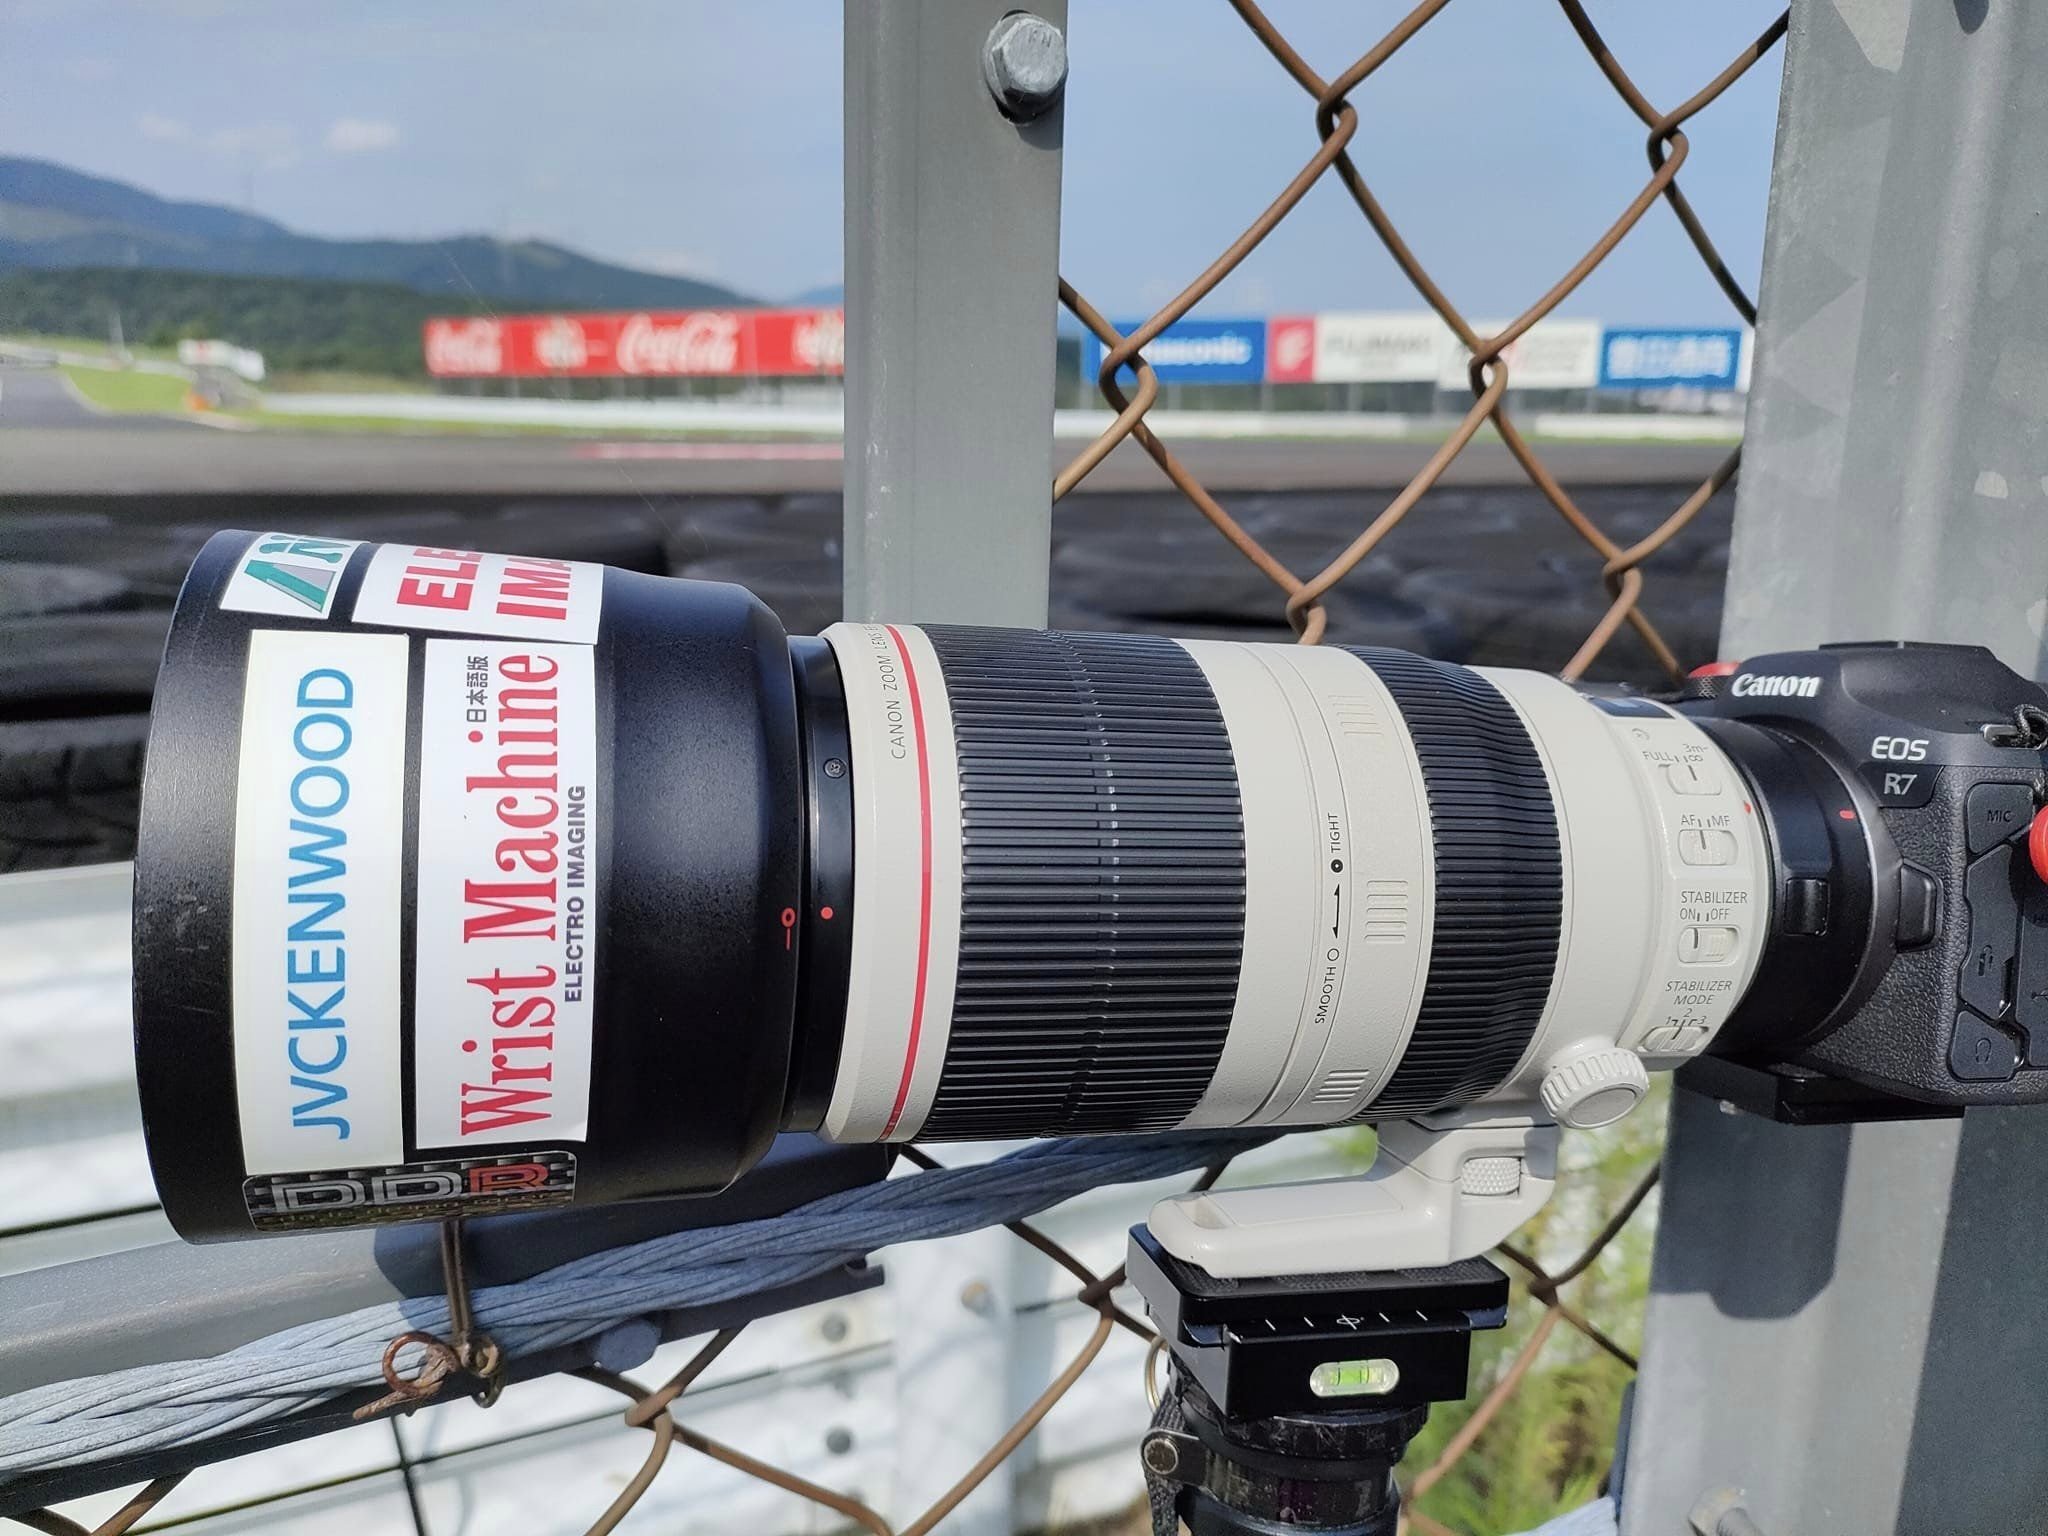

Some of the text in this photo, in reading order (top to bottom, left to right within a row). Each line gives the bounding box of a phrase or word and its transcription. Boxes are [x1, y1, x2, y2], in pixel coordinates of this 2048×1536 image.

[877, 655, 898, 691] ZOOM
[1731, 673, 1821, 698] Canon
[466, 655, 489, 723] 日本語版
[886, 700, 906, 759] CANON
[1642, 751, 1674, 761] FULL
[1872, 736, 1929, 761] EOS
[1884, 773, 1918, 795] R7
[1681, 815, 1730, 826] AF MF
[1987, 809, 2012, 823] MIC
[1328, 813, 1341, 853] TIGHT
[287, 668, 355, 1140] JVCKENWOOD
[461, 654, 561, 1136] Wrist Machine
[565, 785, 587, 1002] ELECTRO IMAGING
[1681, 891, 1748, 904] STABILIZER
[1680, 908, 1730, 920] ON OFF
[1315, 966, 1337, 1024] SMOOTH
[1665, 980, 1733, 992] STABILIZER
[1673, 994, 1715, 1005] MODE
[271, 1163, 549, 1213] DDR
